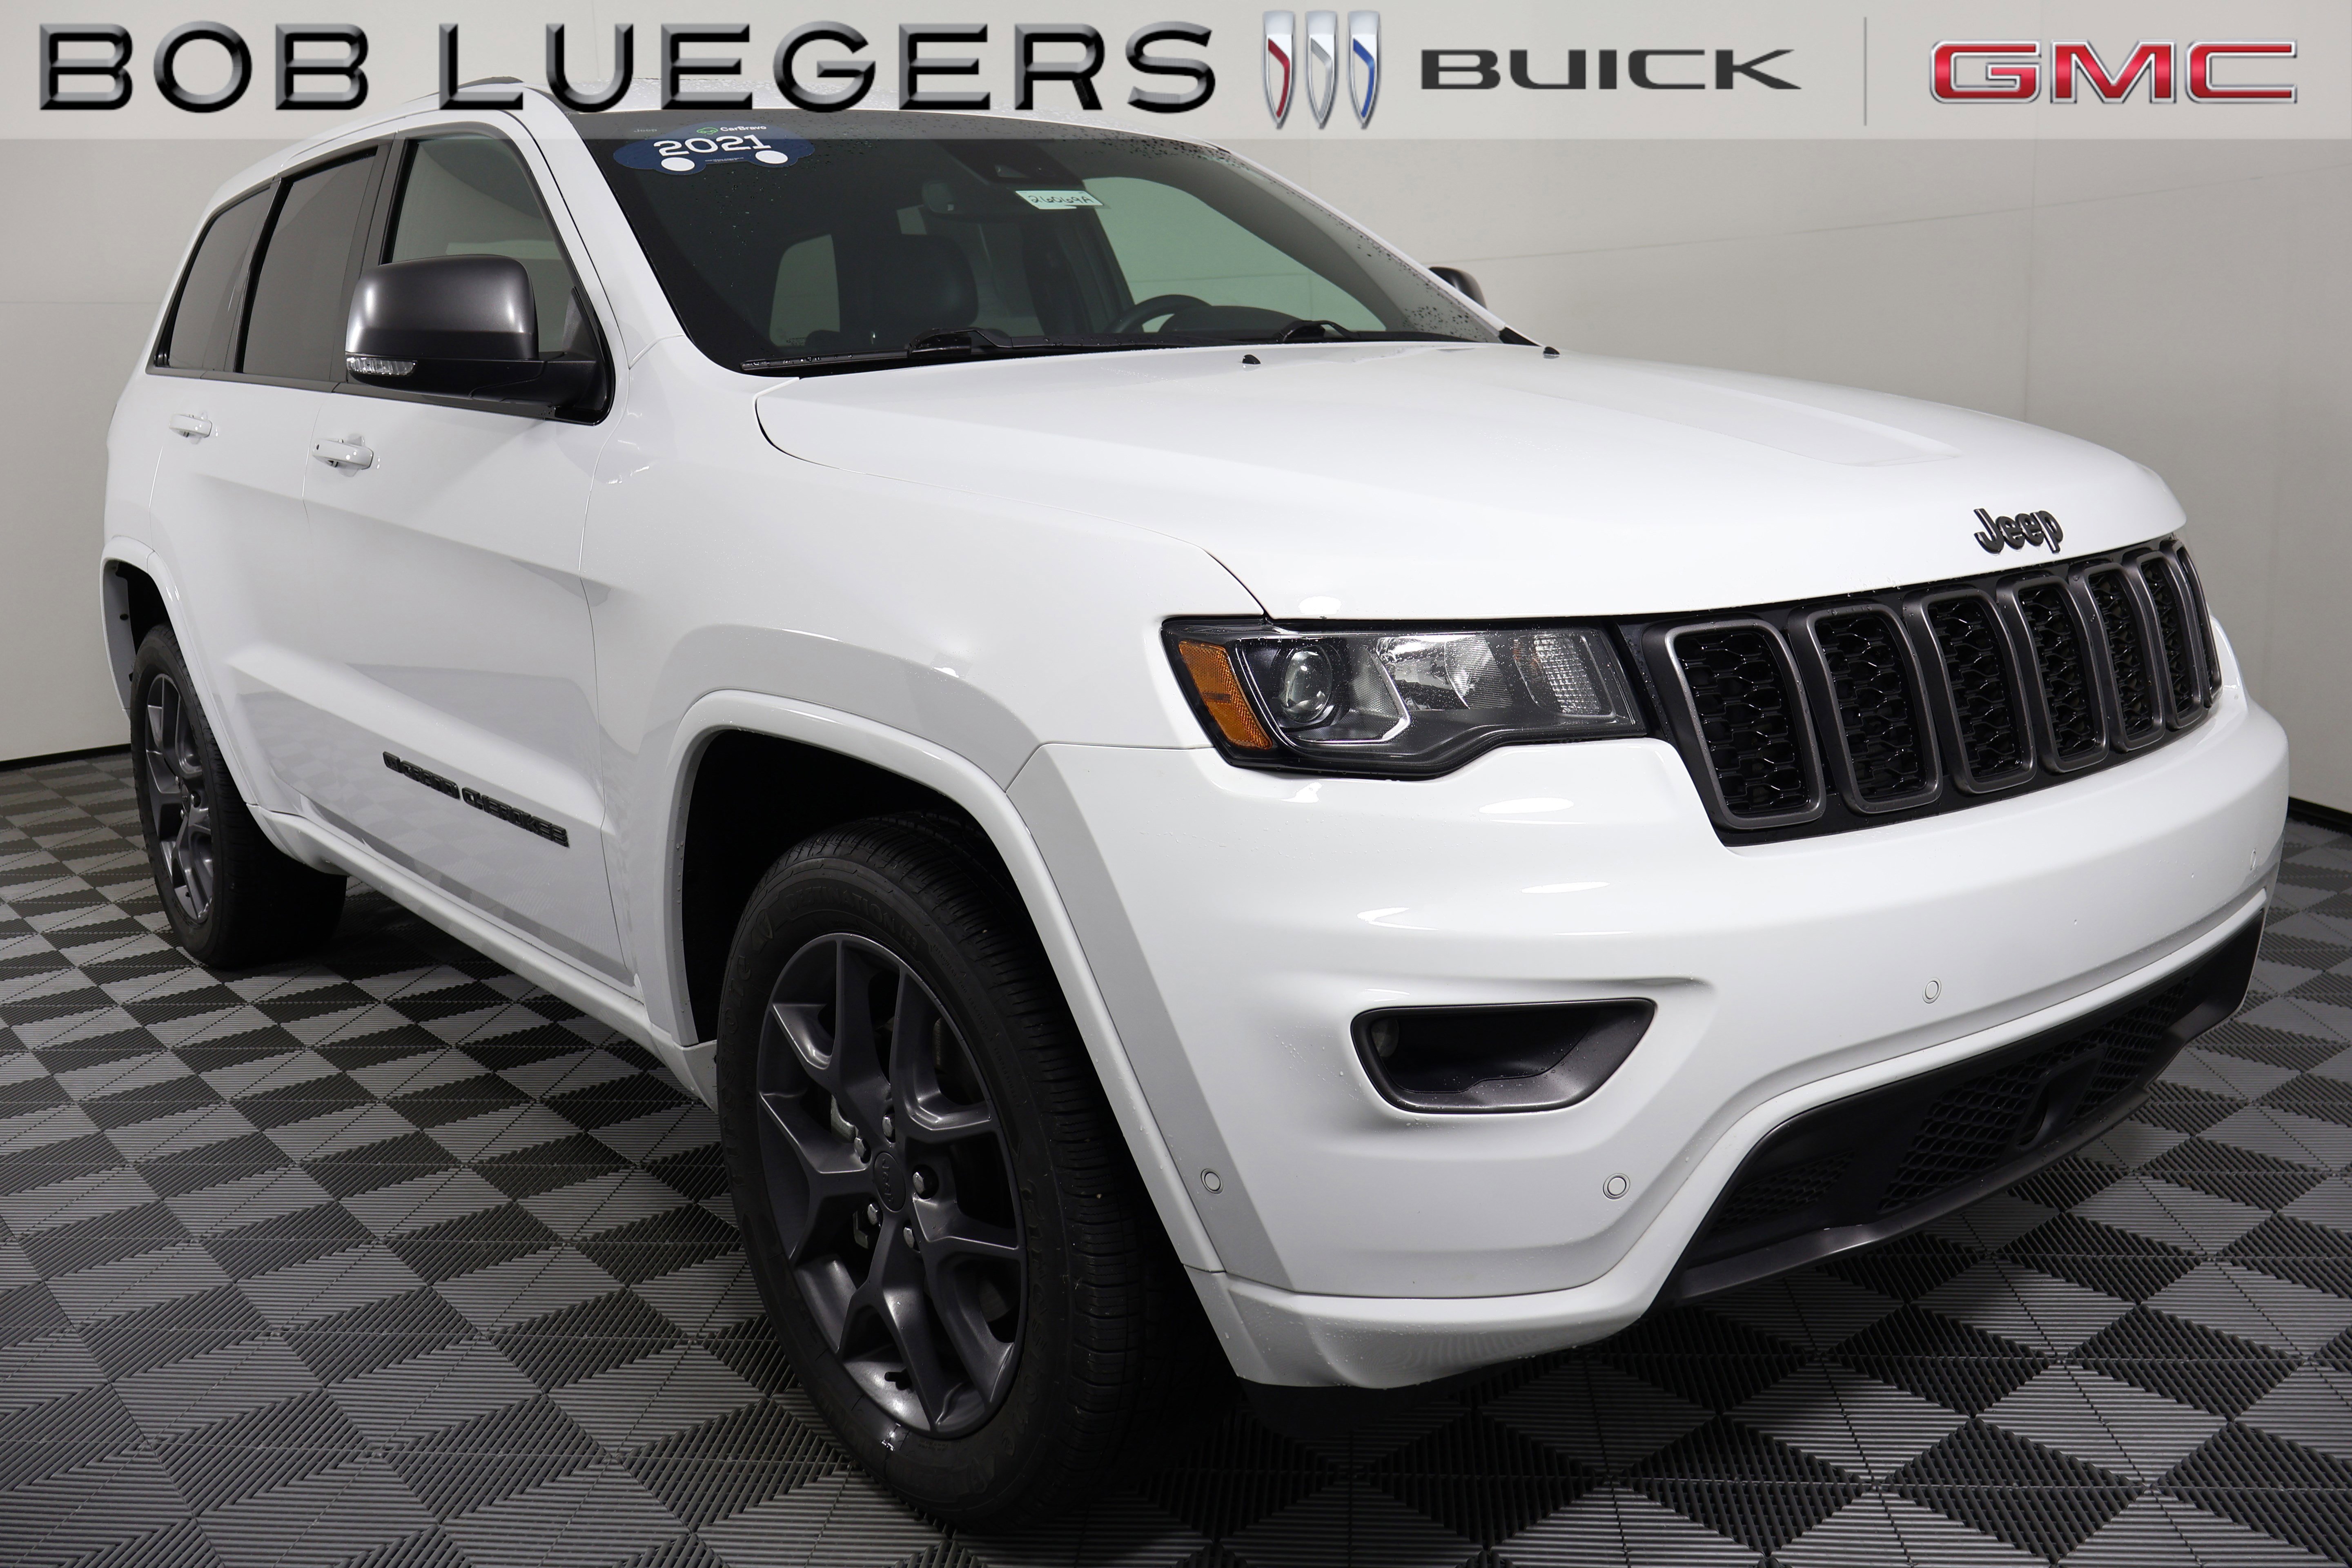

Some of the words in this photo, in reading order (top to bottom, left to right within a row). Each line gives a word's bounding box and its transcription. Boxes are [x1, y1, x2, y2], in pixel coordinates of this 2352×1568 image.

[653, 134, 771, 156] 2021
[1973, 508, 2064, 554] Jeep
[401, 760, 461, 800] GRAND
[461, 787, 569, 848] CHEROKEE
[882, 1158, 895, 1205] Jeep
